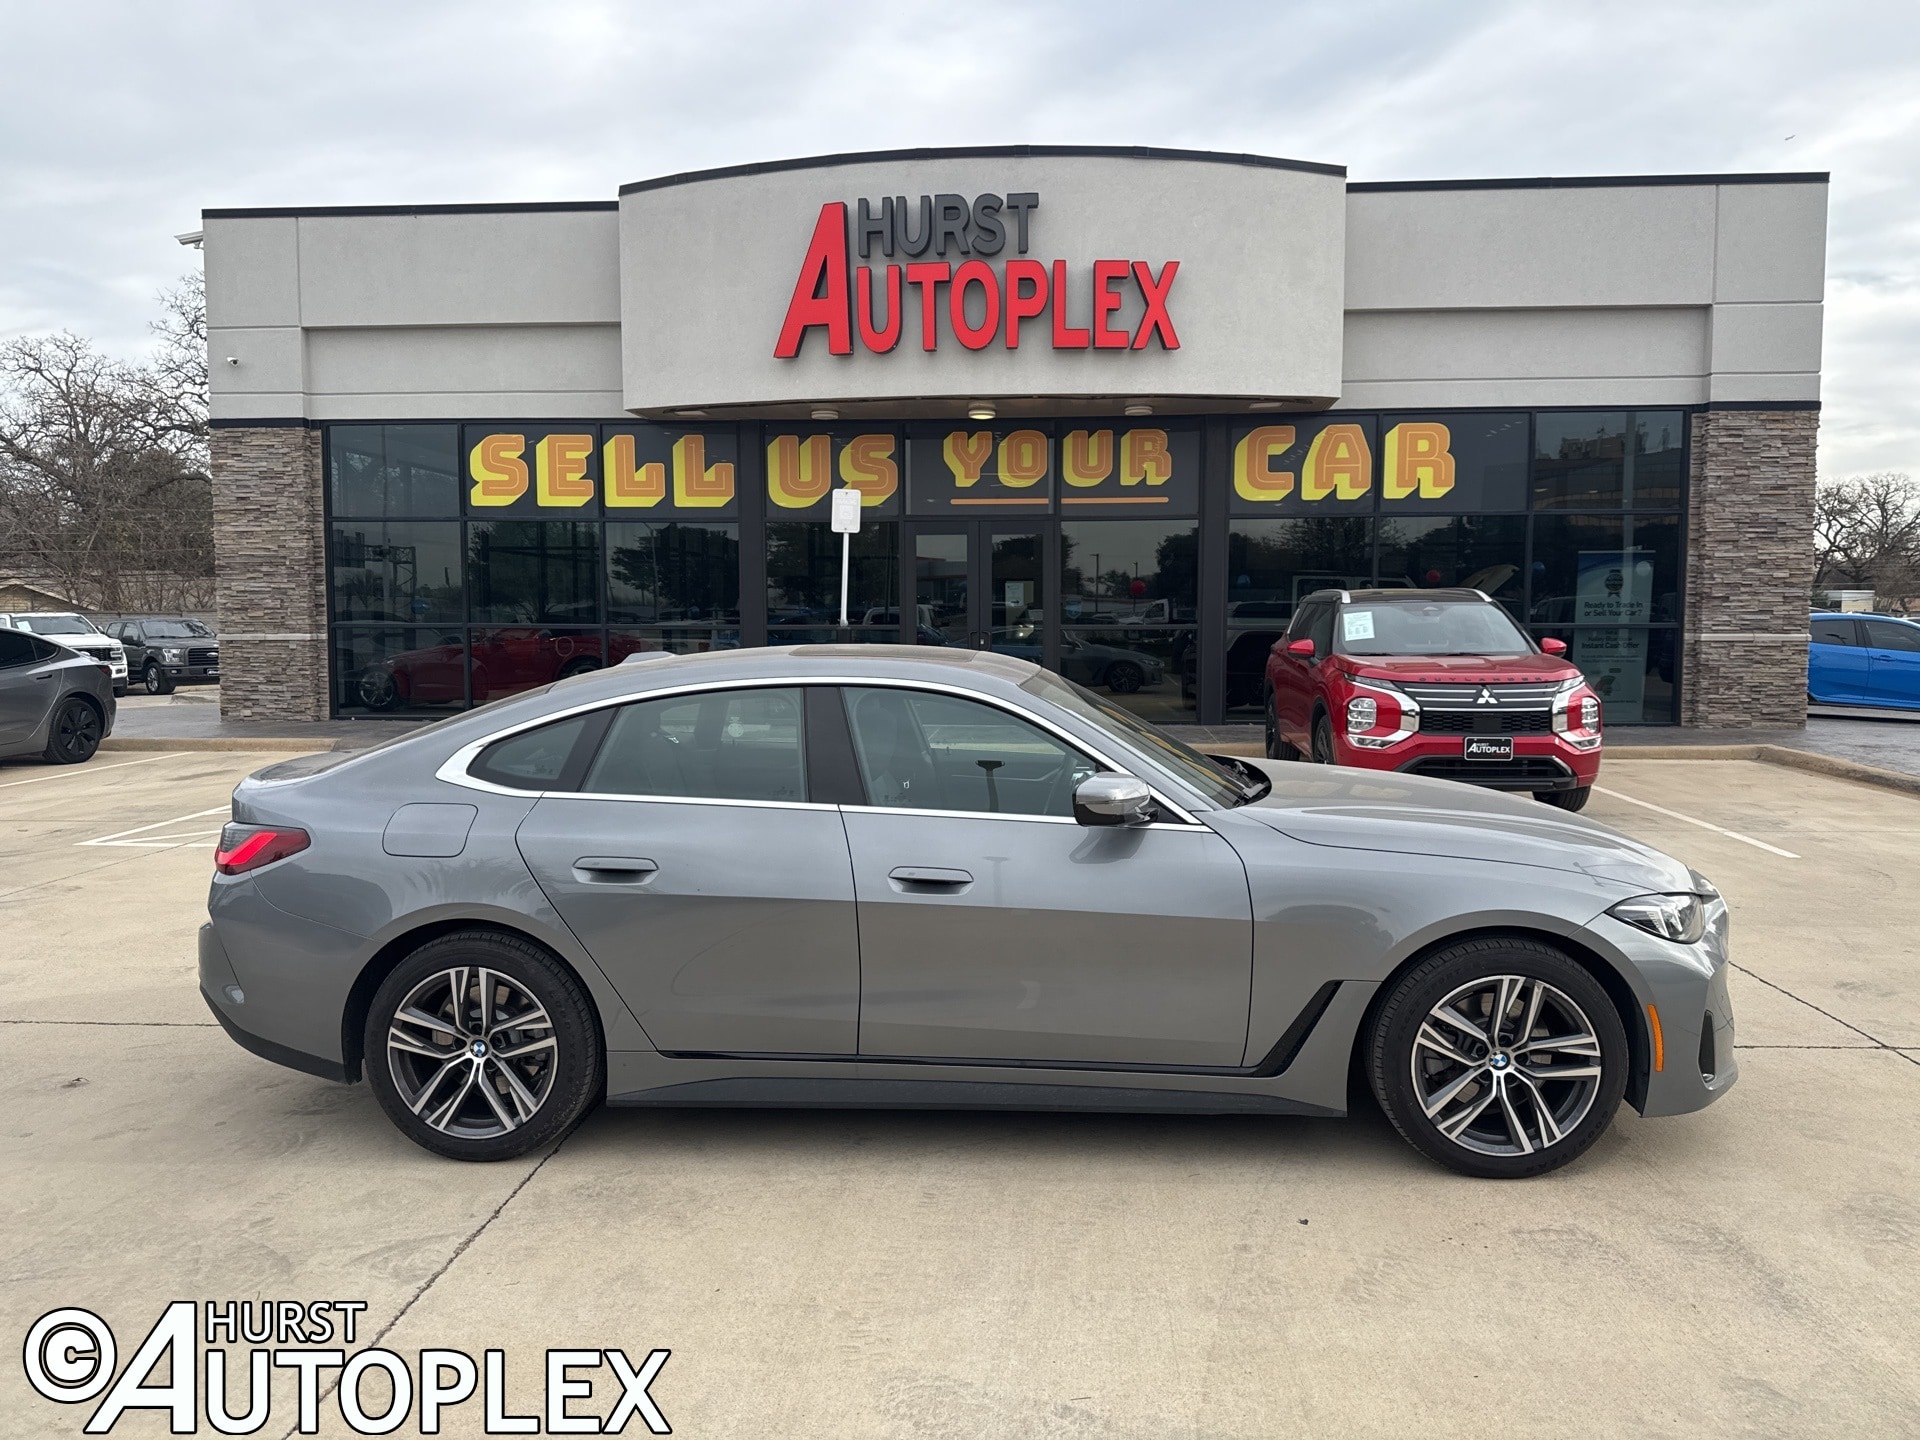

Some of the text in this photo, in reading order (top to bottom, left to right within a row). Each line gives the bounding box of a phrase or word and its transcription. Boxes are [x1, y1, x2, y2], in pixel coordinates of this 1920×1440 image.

[858, 192, 1039, 259] HURST
[773, 202, 1181, 359] AUTOPLEX
[469, 422, 1456, 509] SELL US YOUR CAR
[1584, 601, 1605, 609] Ready
[1467, 742, 1511, 753] AUTOPLEX
